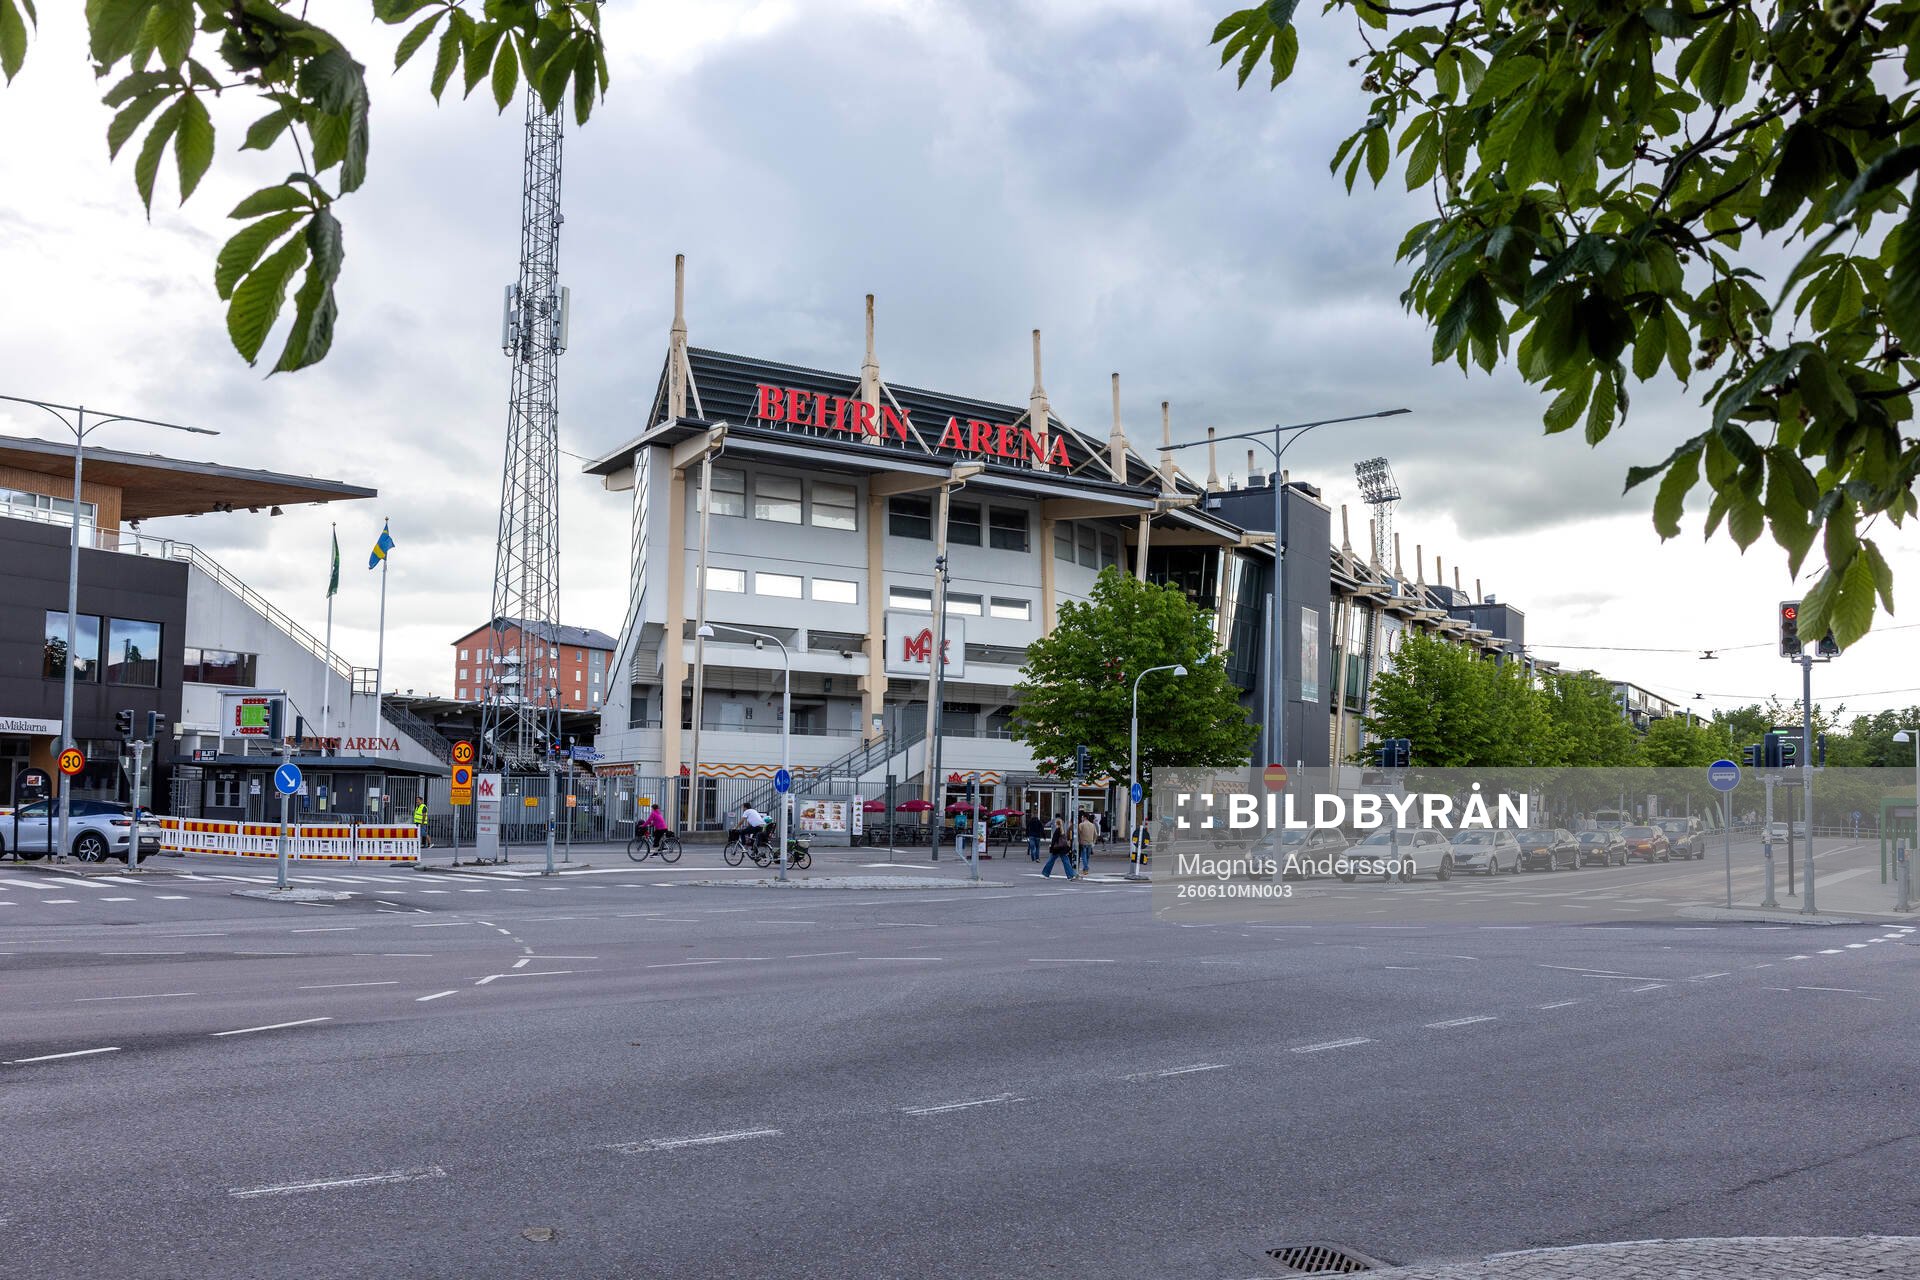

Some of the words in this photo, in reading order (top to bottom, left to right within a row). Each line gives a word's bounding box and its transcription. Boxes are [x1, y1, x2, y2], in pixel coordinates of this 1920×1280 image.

[757, 383, 912, 443] BEHRN
[938, 416, 1073, 468] ARENA
[344, 737, 400, 751] ARENA
[456, 746, 471, 758] 30
[63, 755, 81, 768] 30
[478, 778, 495, 796] MAX
